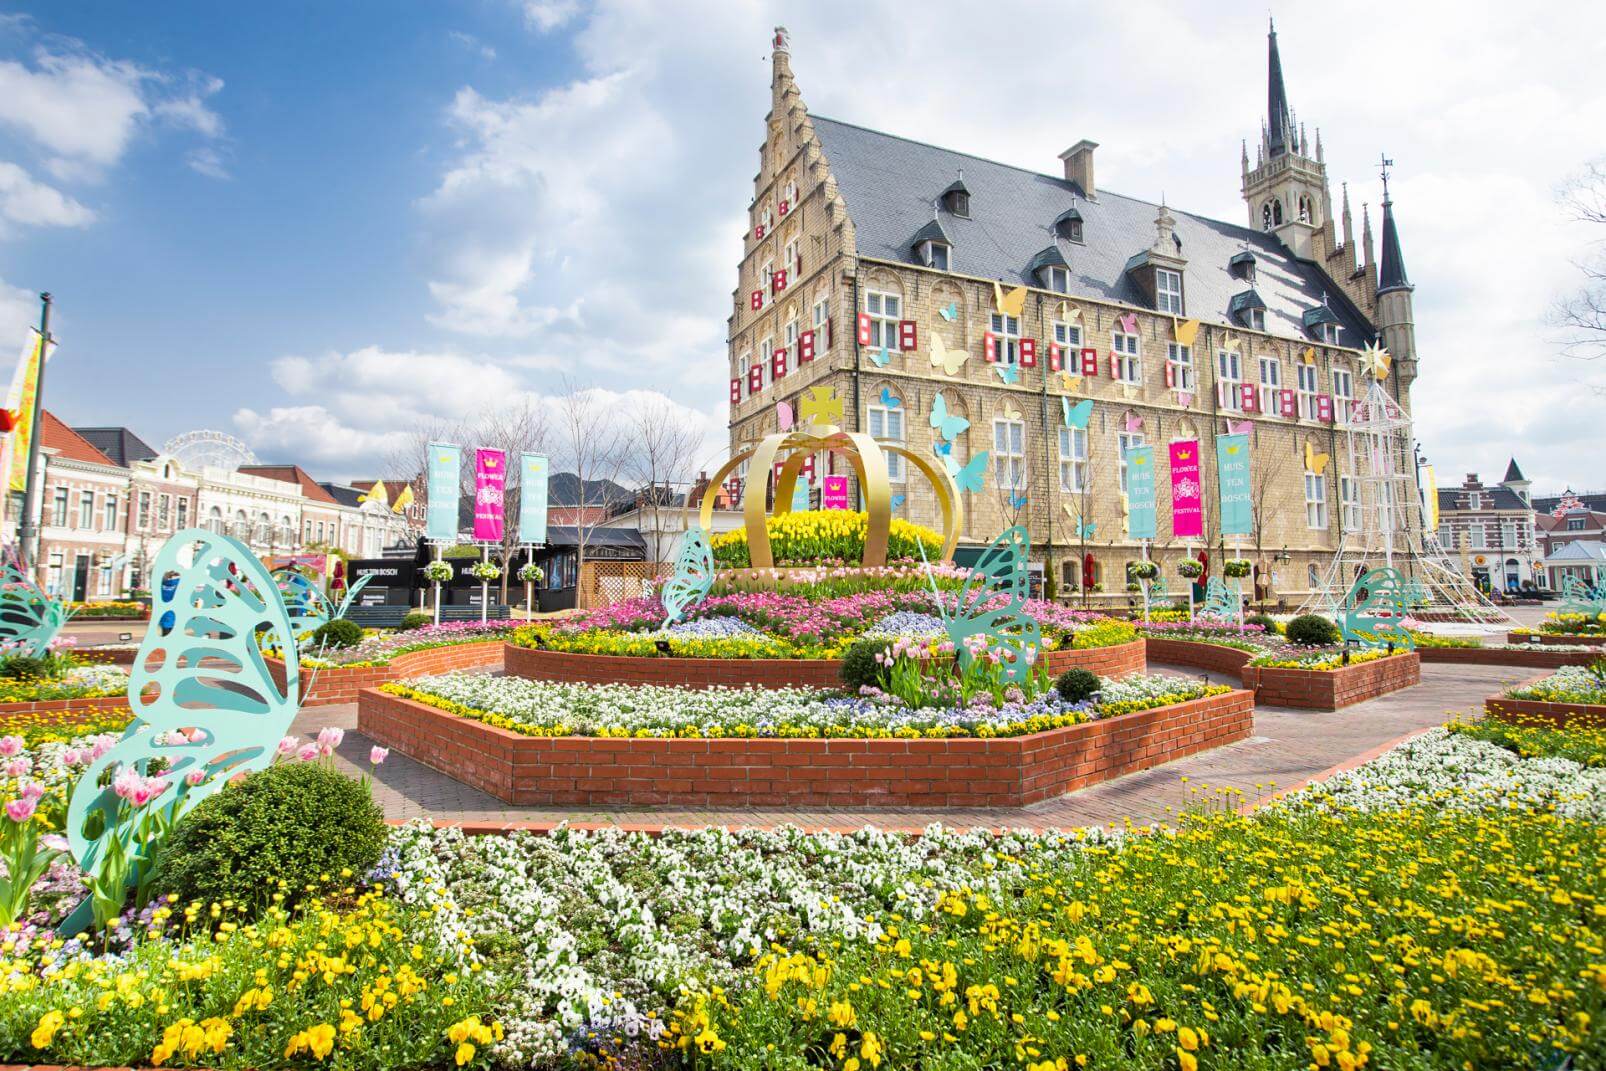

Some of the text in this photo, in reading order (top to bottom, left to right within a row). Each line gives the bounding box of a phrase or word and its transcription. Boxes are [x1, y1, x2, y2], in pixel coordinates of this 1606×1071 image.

[1172, 465, 1198, 473] FLOWER
[1223, 463, 1245, 472] HUIS
[1226, 478, 1244, 487] TEN
[1134, 487, 1149, 495] TEN
[1221, 493, 1251, 503] BOSCH
[1174, 507, 1201, 515] FESTIVAL
